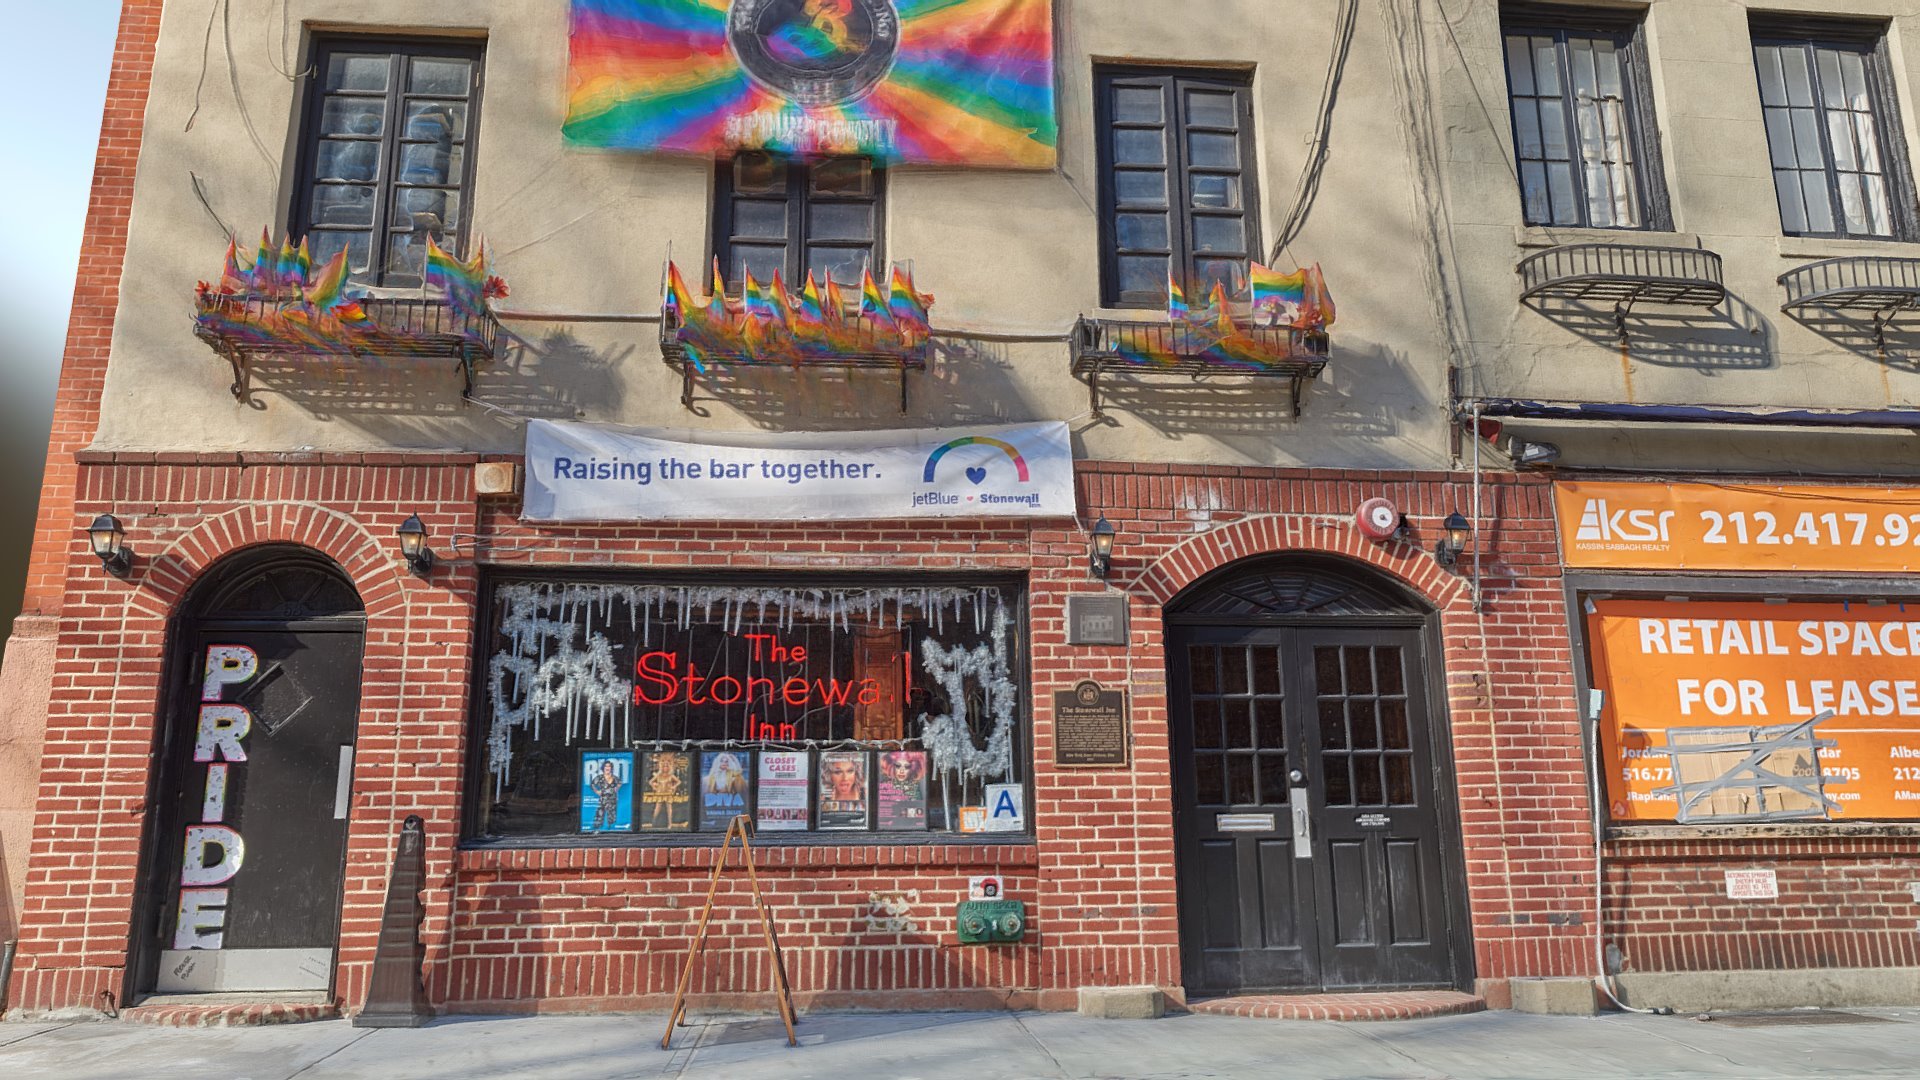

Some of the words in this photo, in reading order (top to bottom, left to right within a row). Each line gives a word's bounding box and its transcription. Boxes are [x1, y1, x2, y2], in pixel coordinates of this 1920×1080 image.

[553, 457, 651, 485] Raising
[659, 458, 702, 480] the
[709, 458, 755, 479] bar
[761, 459, 882, 484] together.
[912, 492, 959, 508] jetBlue
[980, 493, 1040, 504] Stonewall
[1576, 542, 1605, 550] KASSIN
[1605, 543, 1641, 551] SABBAGH
[744, 633, 807, 663] The
[1638, 618, 1790, 655] RETAIL
[634, 651, 912, 706] Stonewal
[1677, 678, 1769, 716] FOR
[1786, 679, 1920, 716] LEASE
[750, 713, 796, 741] Inn
[173, 644, 258, 950] PRIDE
[704, 792, 745, 807] DIVA
[993, 789, 1018, 818] A
